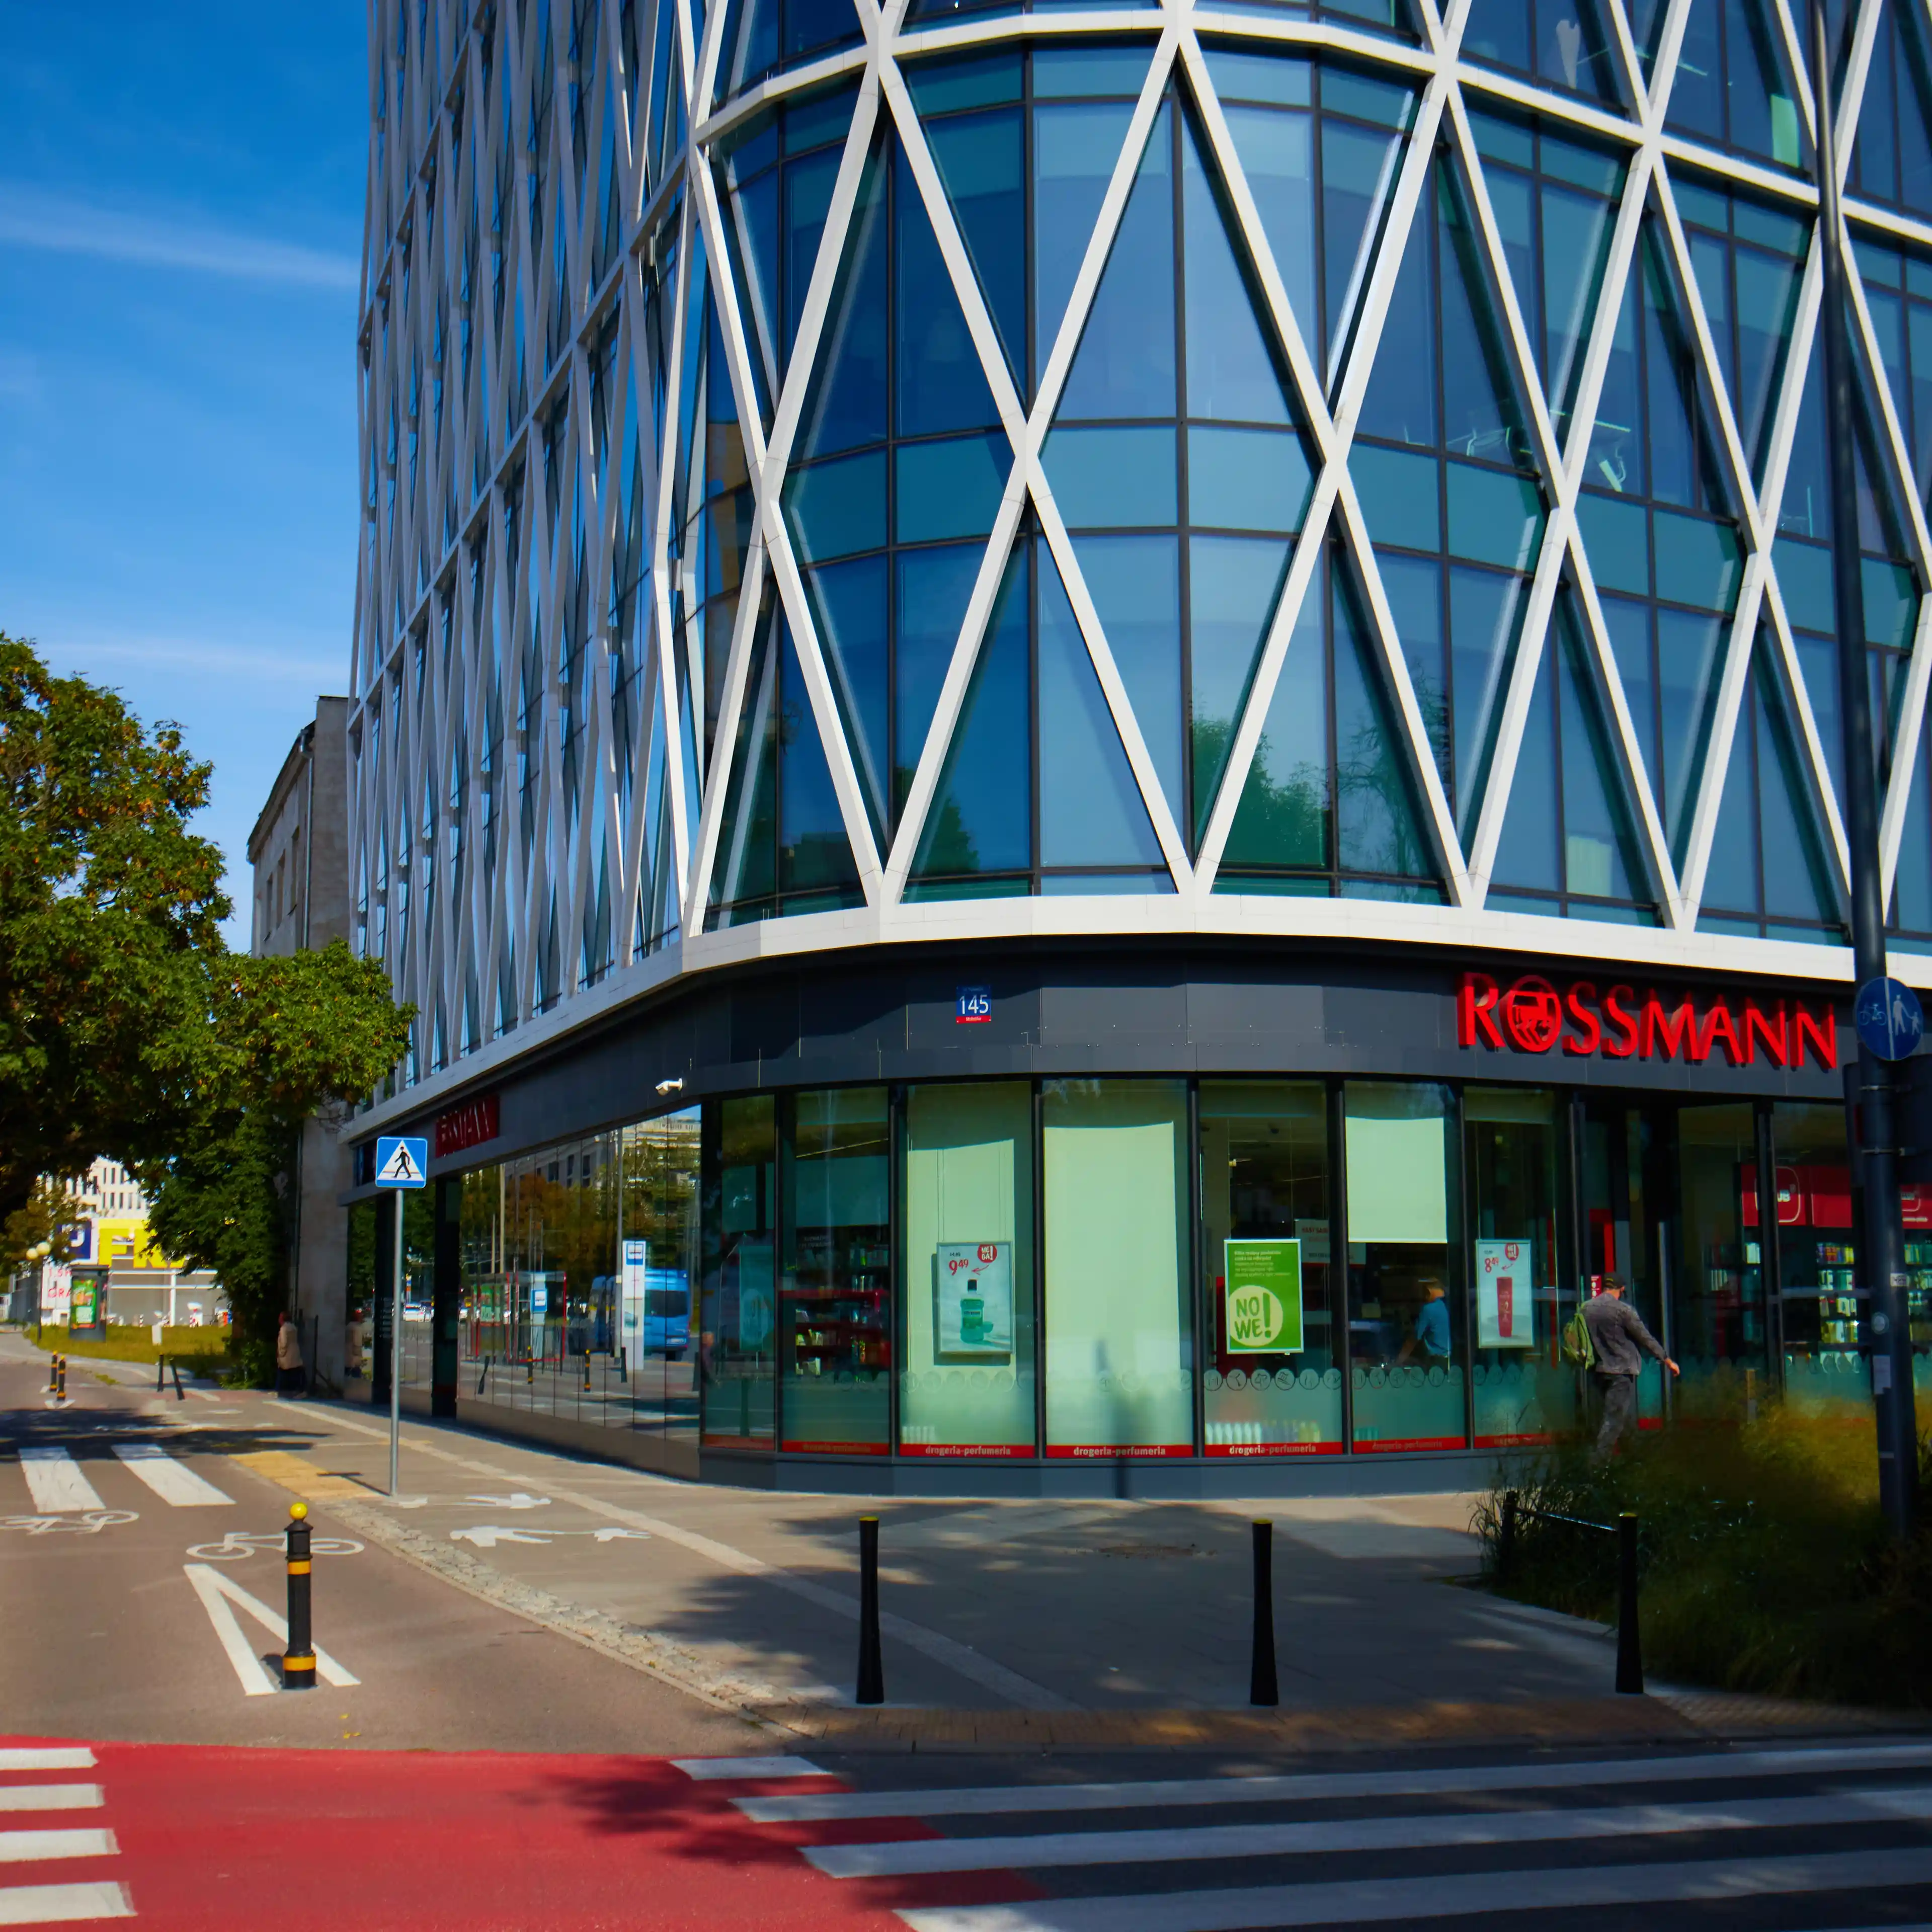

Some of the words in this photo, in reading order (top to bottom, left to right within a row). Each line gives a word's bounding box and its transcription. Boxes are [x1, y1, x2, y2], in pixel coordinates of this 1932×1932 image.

[959, 994, 989, 1014] 145
[1456, 972, 1837, 1070] ROSSMANN
[925, 1445, 1011, 1457] drogeria-perfumeria
[1073, 1446, 1166, 1458] drogeria-perfumeria
[1229, 1443, 1317, 1456] drogeria-perfumeria
